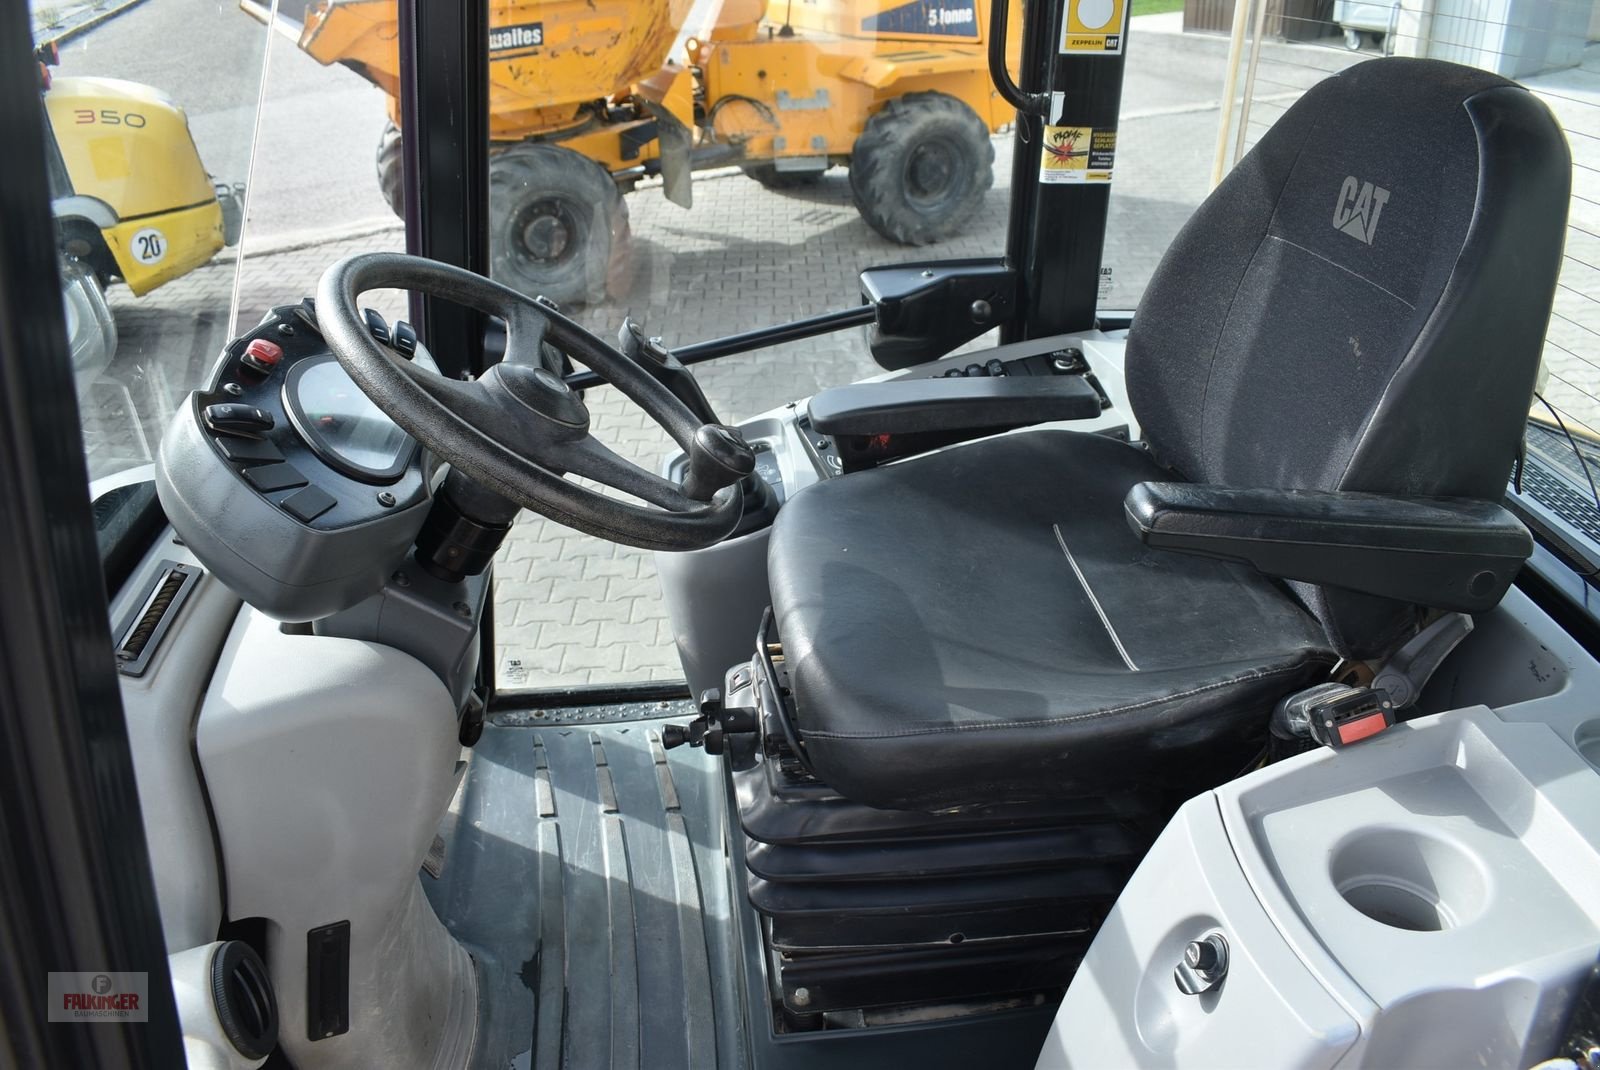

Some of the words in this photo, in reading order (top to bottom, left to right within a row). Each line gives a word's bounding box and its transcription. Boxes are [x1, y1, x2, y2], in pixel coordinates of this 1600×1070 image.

[928, 8, 937, 27] 5
[939, 7, 973, 26] tonne
[1106, 38, 1118, 48] CAT
[74, 109, 146, 129] 350
[1332, 175, 1391, 246] CAT
[138, 233, 161, 260] 20
